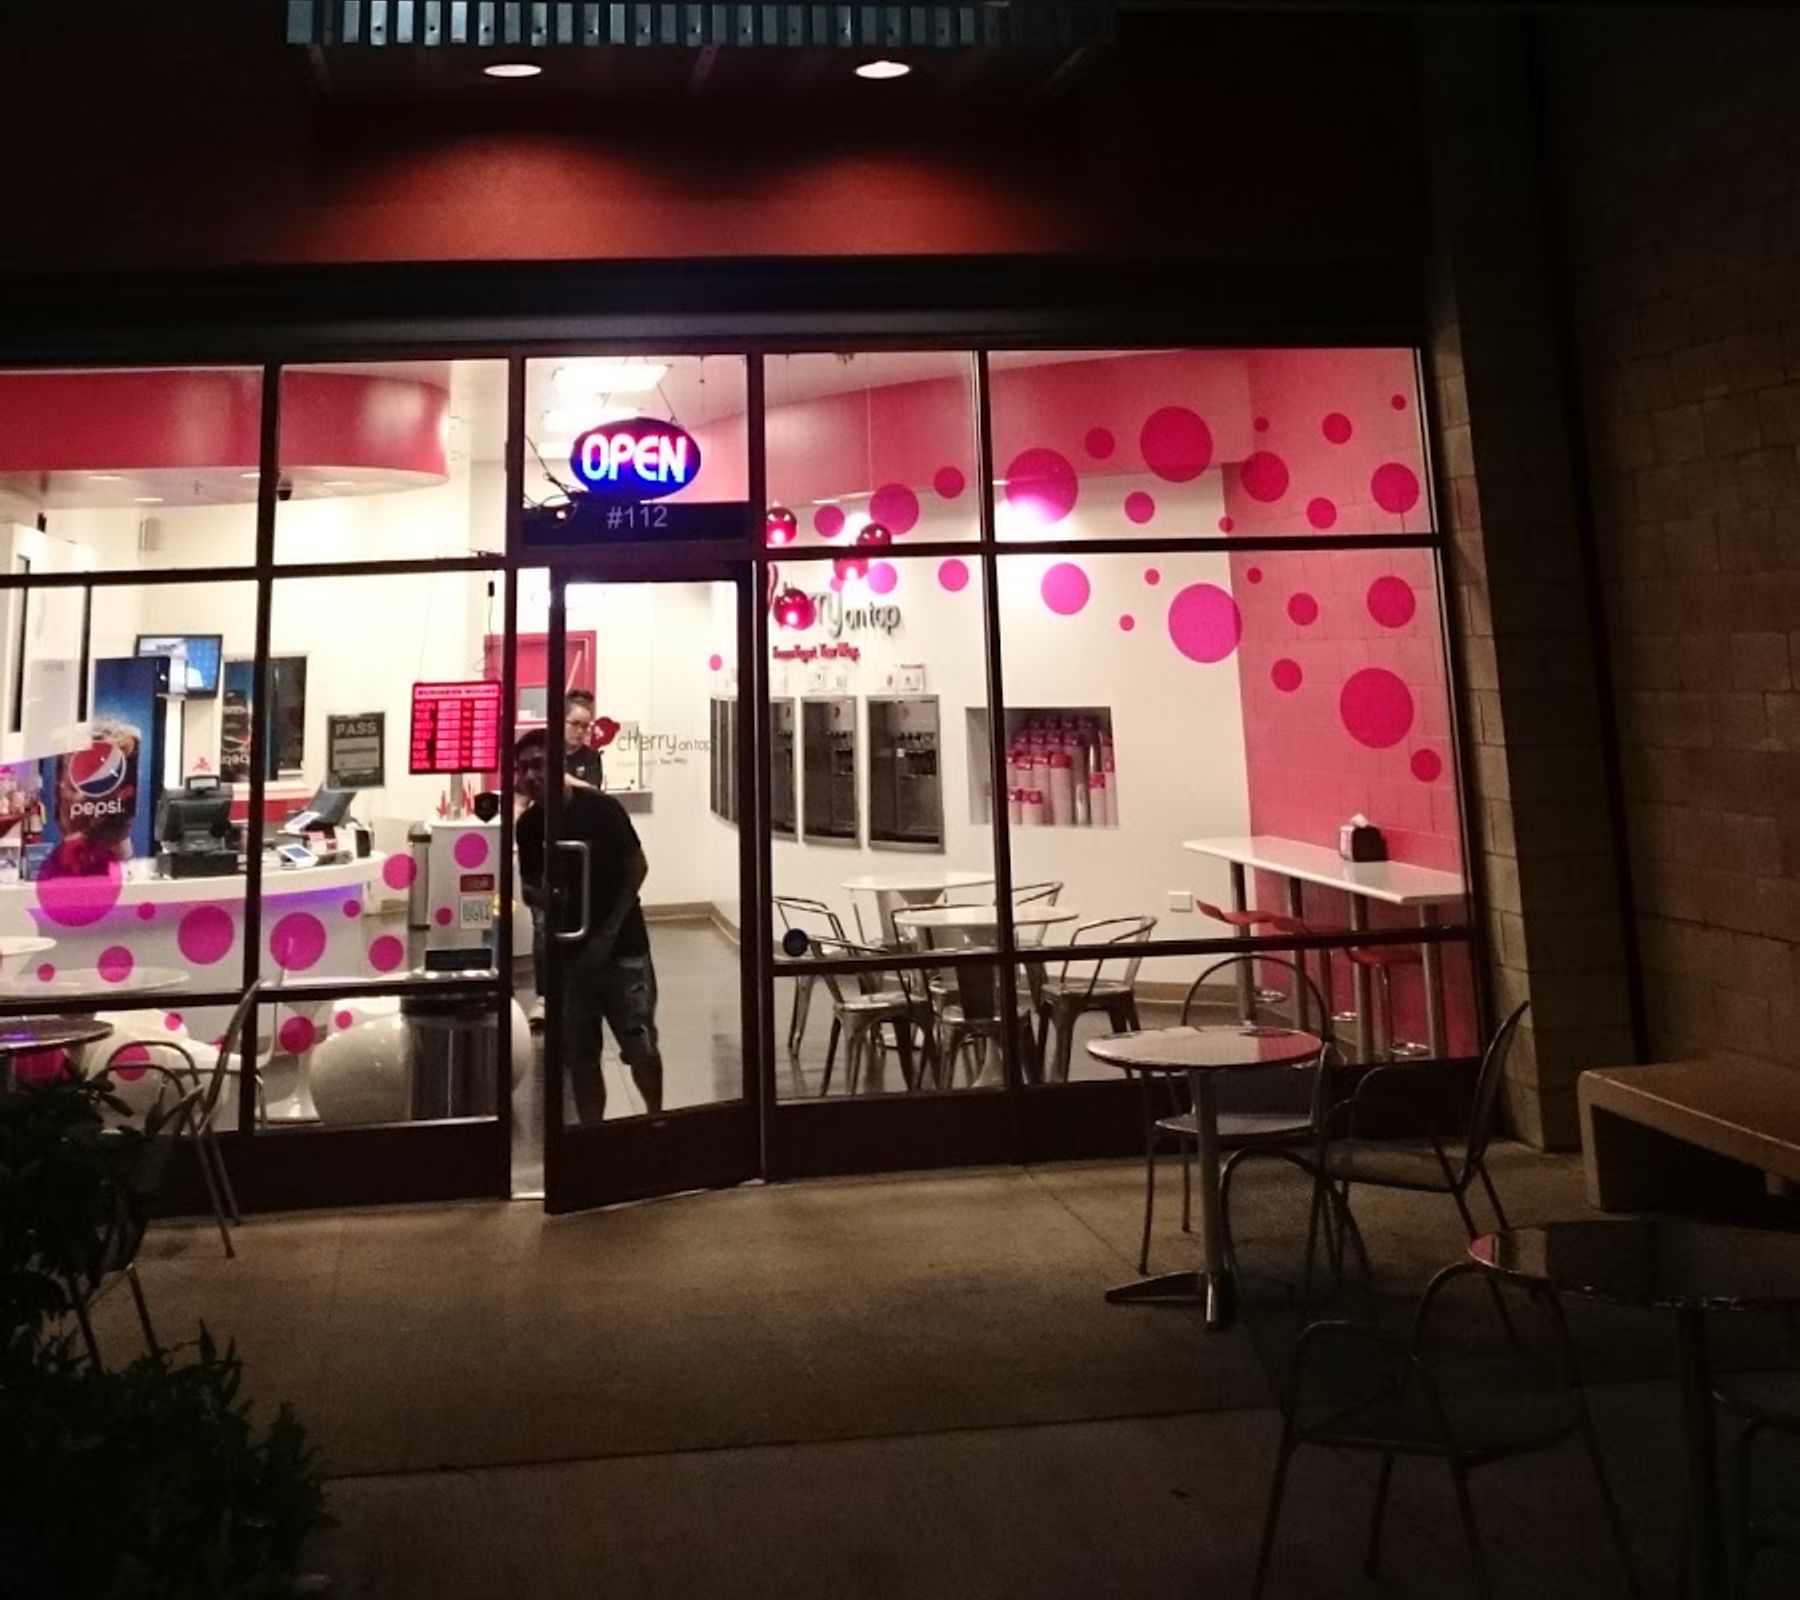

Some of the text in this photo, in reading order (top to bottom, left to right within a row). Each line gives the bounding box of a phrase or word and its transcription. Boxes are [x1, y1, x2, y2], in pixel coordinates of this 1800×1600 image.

[582, 433, 686, 483] OPEN
[607, 505, 668, 529] #112
[335, 721, 377, 737] PASS
[70, 798, 122, 819] pepsi
